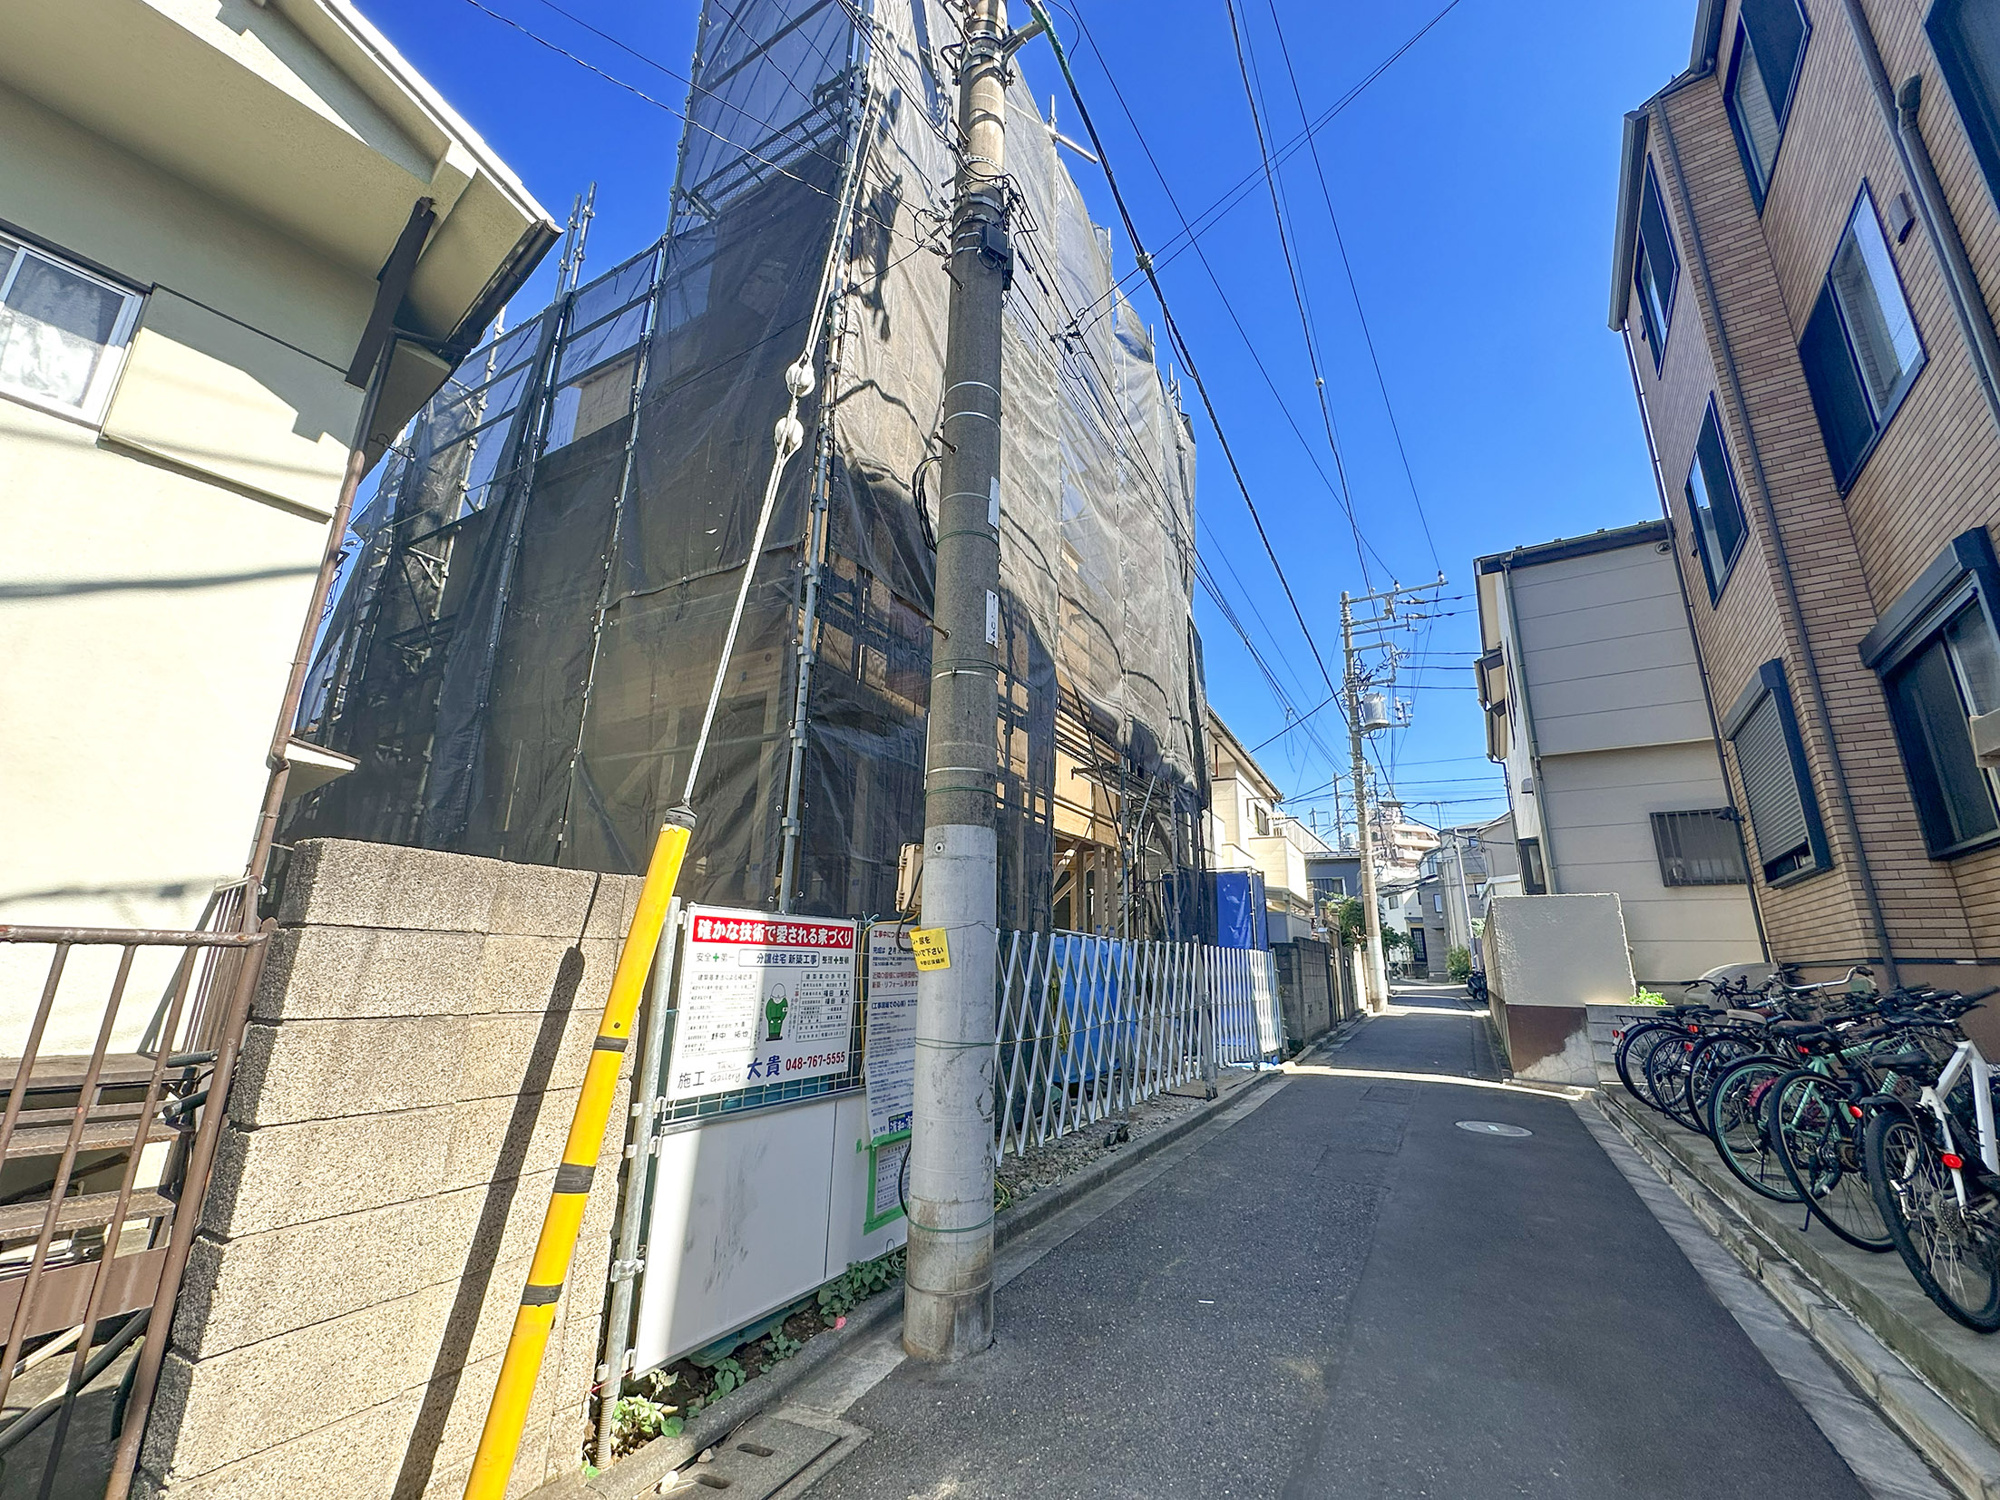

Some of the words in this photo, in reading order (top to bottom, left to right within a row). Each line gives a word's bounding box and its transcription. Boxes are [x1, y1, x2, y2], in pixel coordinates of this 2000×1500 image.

[697, 918, 852, 946] 確かな技術で愛される家づくり
[756, 954, 787, 964] 分譲住宅
[788, 954, 817, 965] 新築工事
[747, 1054, 782, 1080] 大貴
[785, 1051, 846, 1071] 048-767-5555
[677, 1070, 705, 1089] 施工
